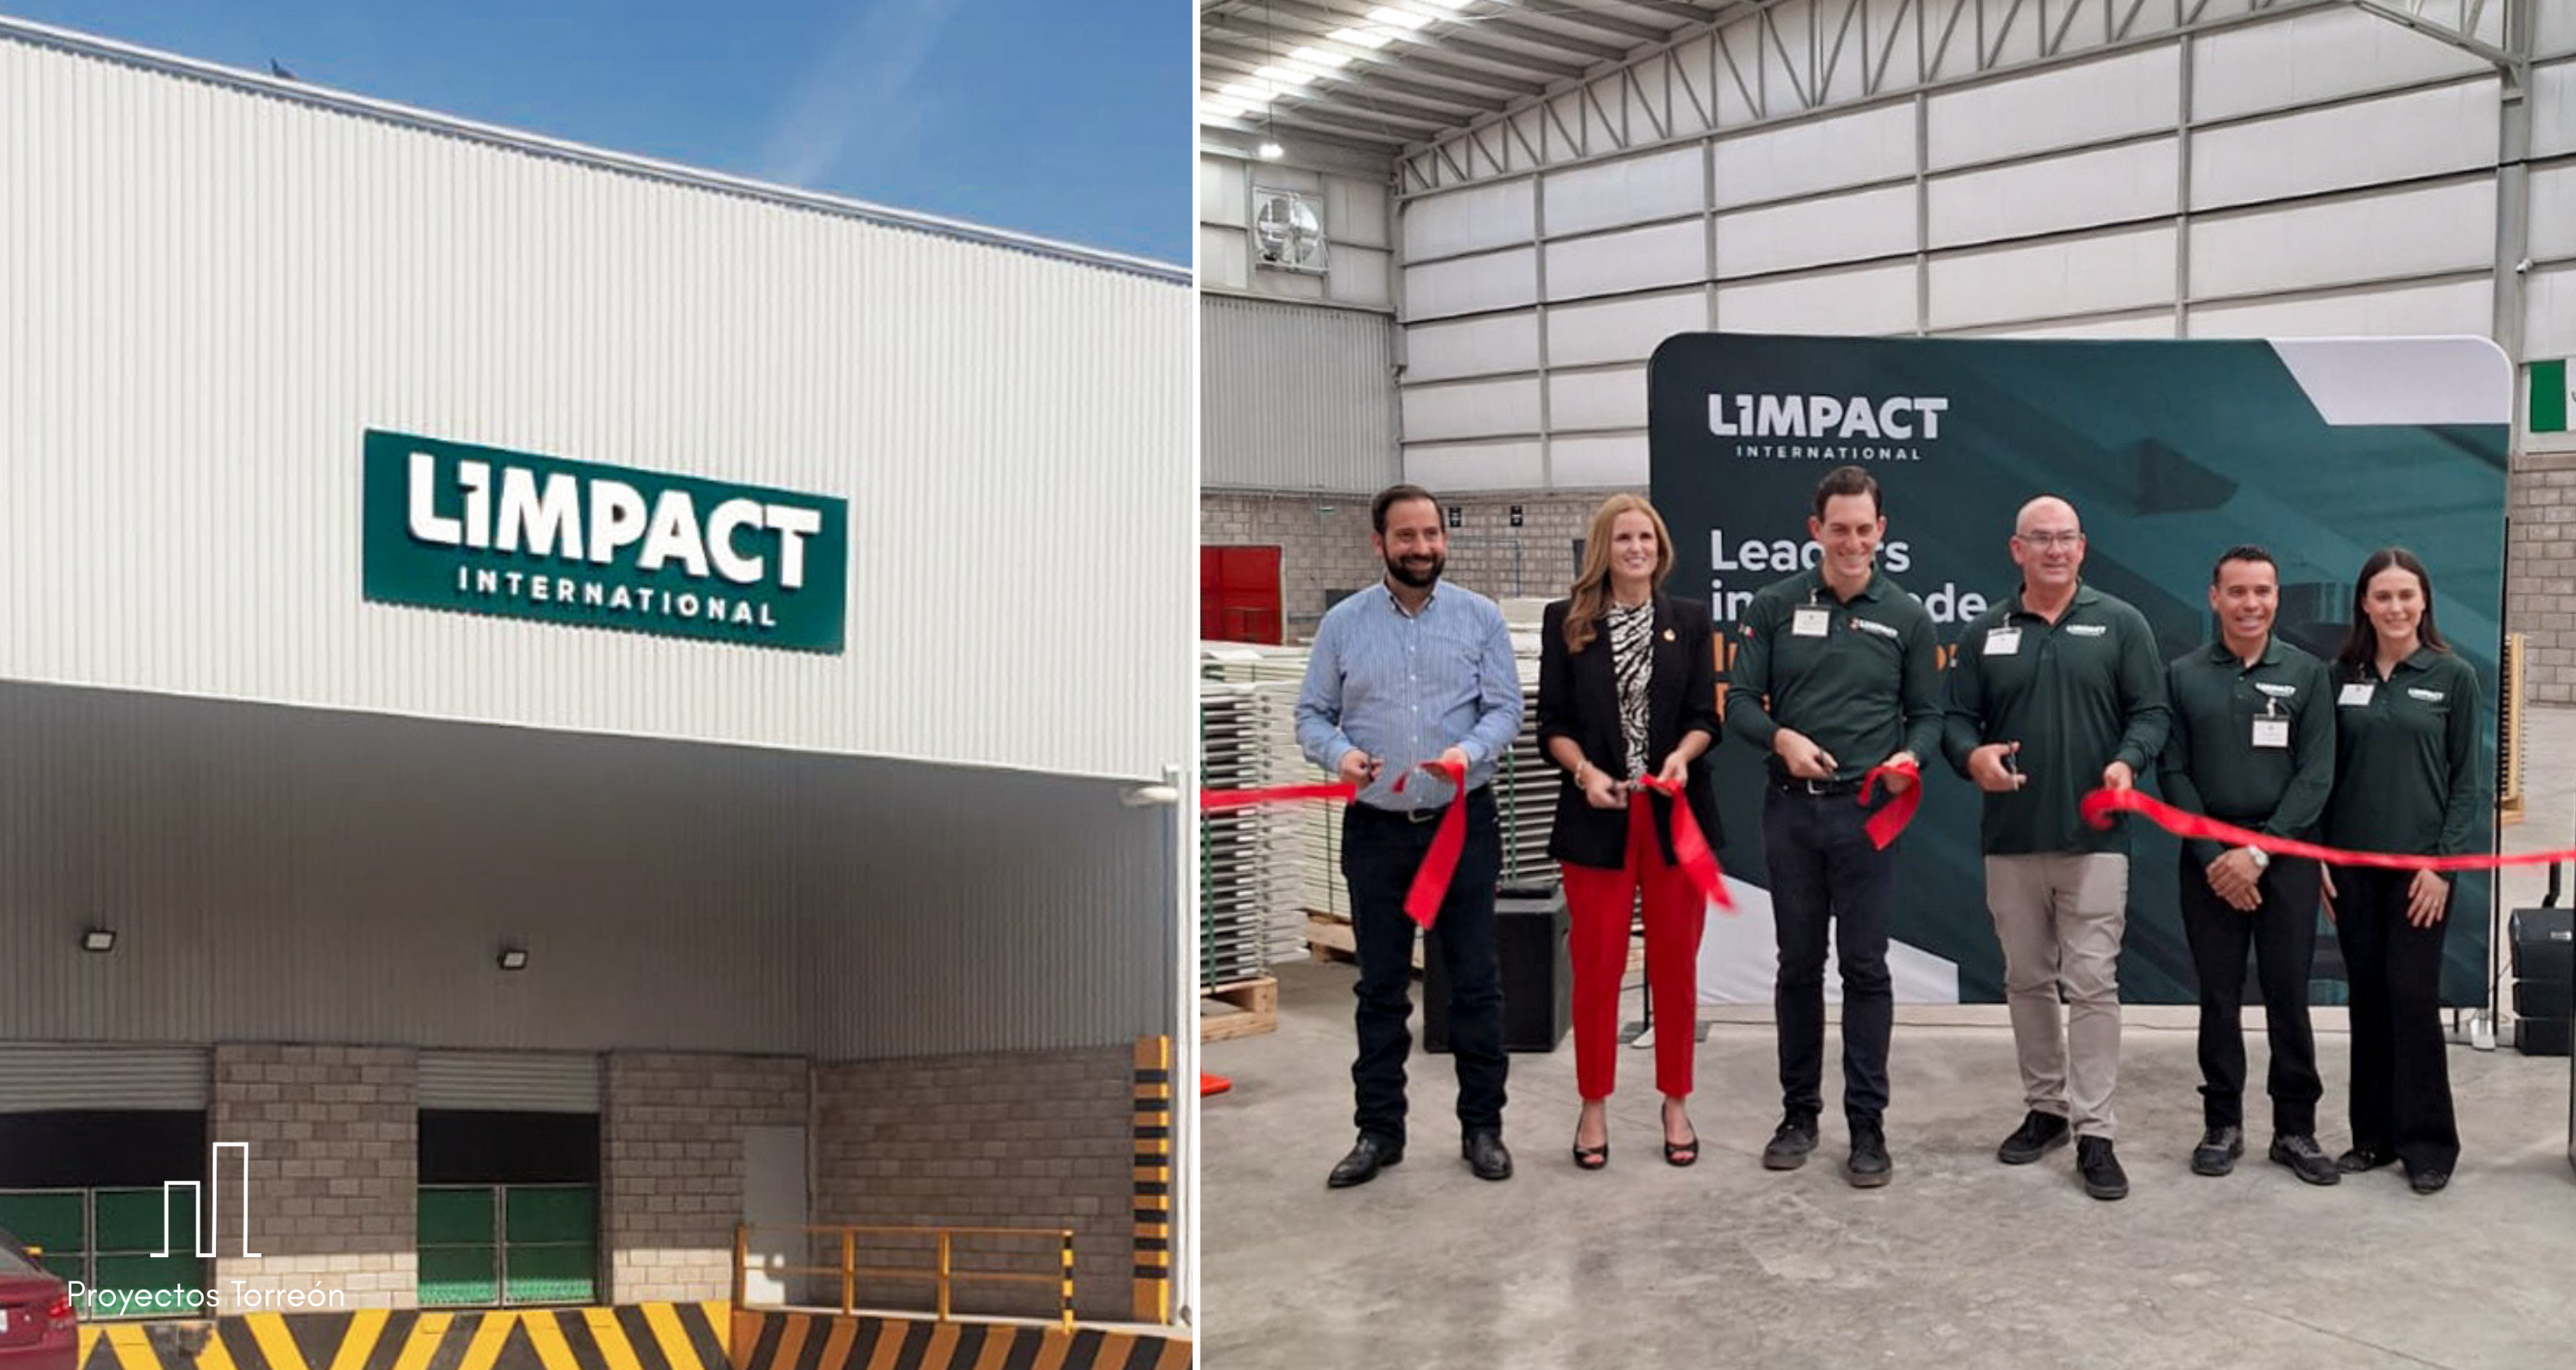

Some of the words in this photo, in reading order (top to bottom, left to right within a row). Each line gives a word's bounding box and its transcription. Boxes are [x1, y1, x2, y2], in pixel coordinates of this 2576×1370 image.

[1736, 446, 1920, 460] INTERNATIONAL
[1710, 529, 1910, 572] Leas
[458, 565, 777, 627] INTERNATIONAL
